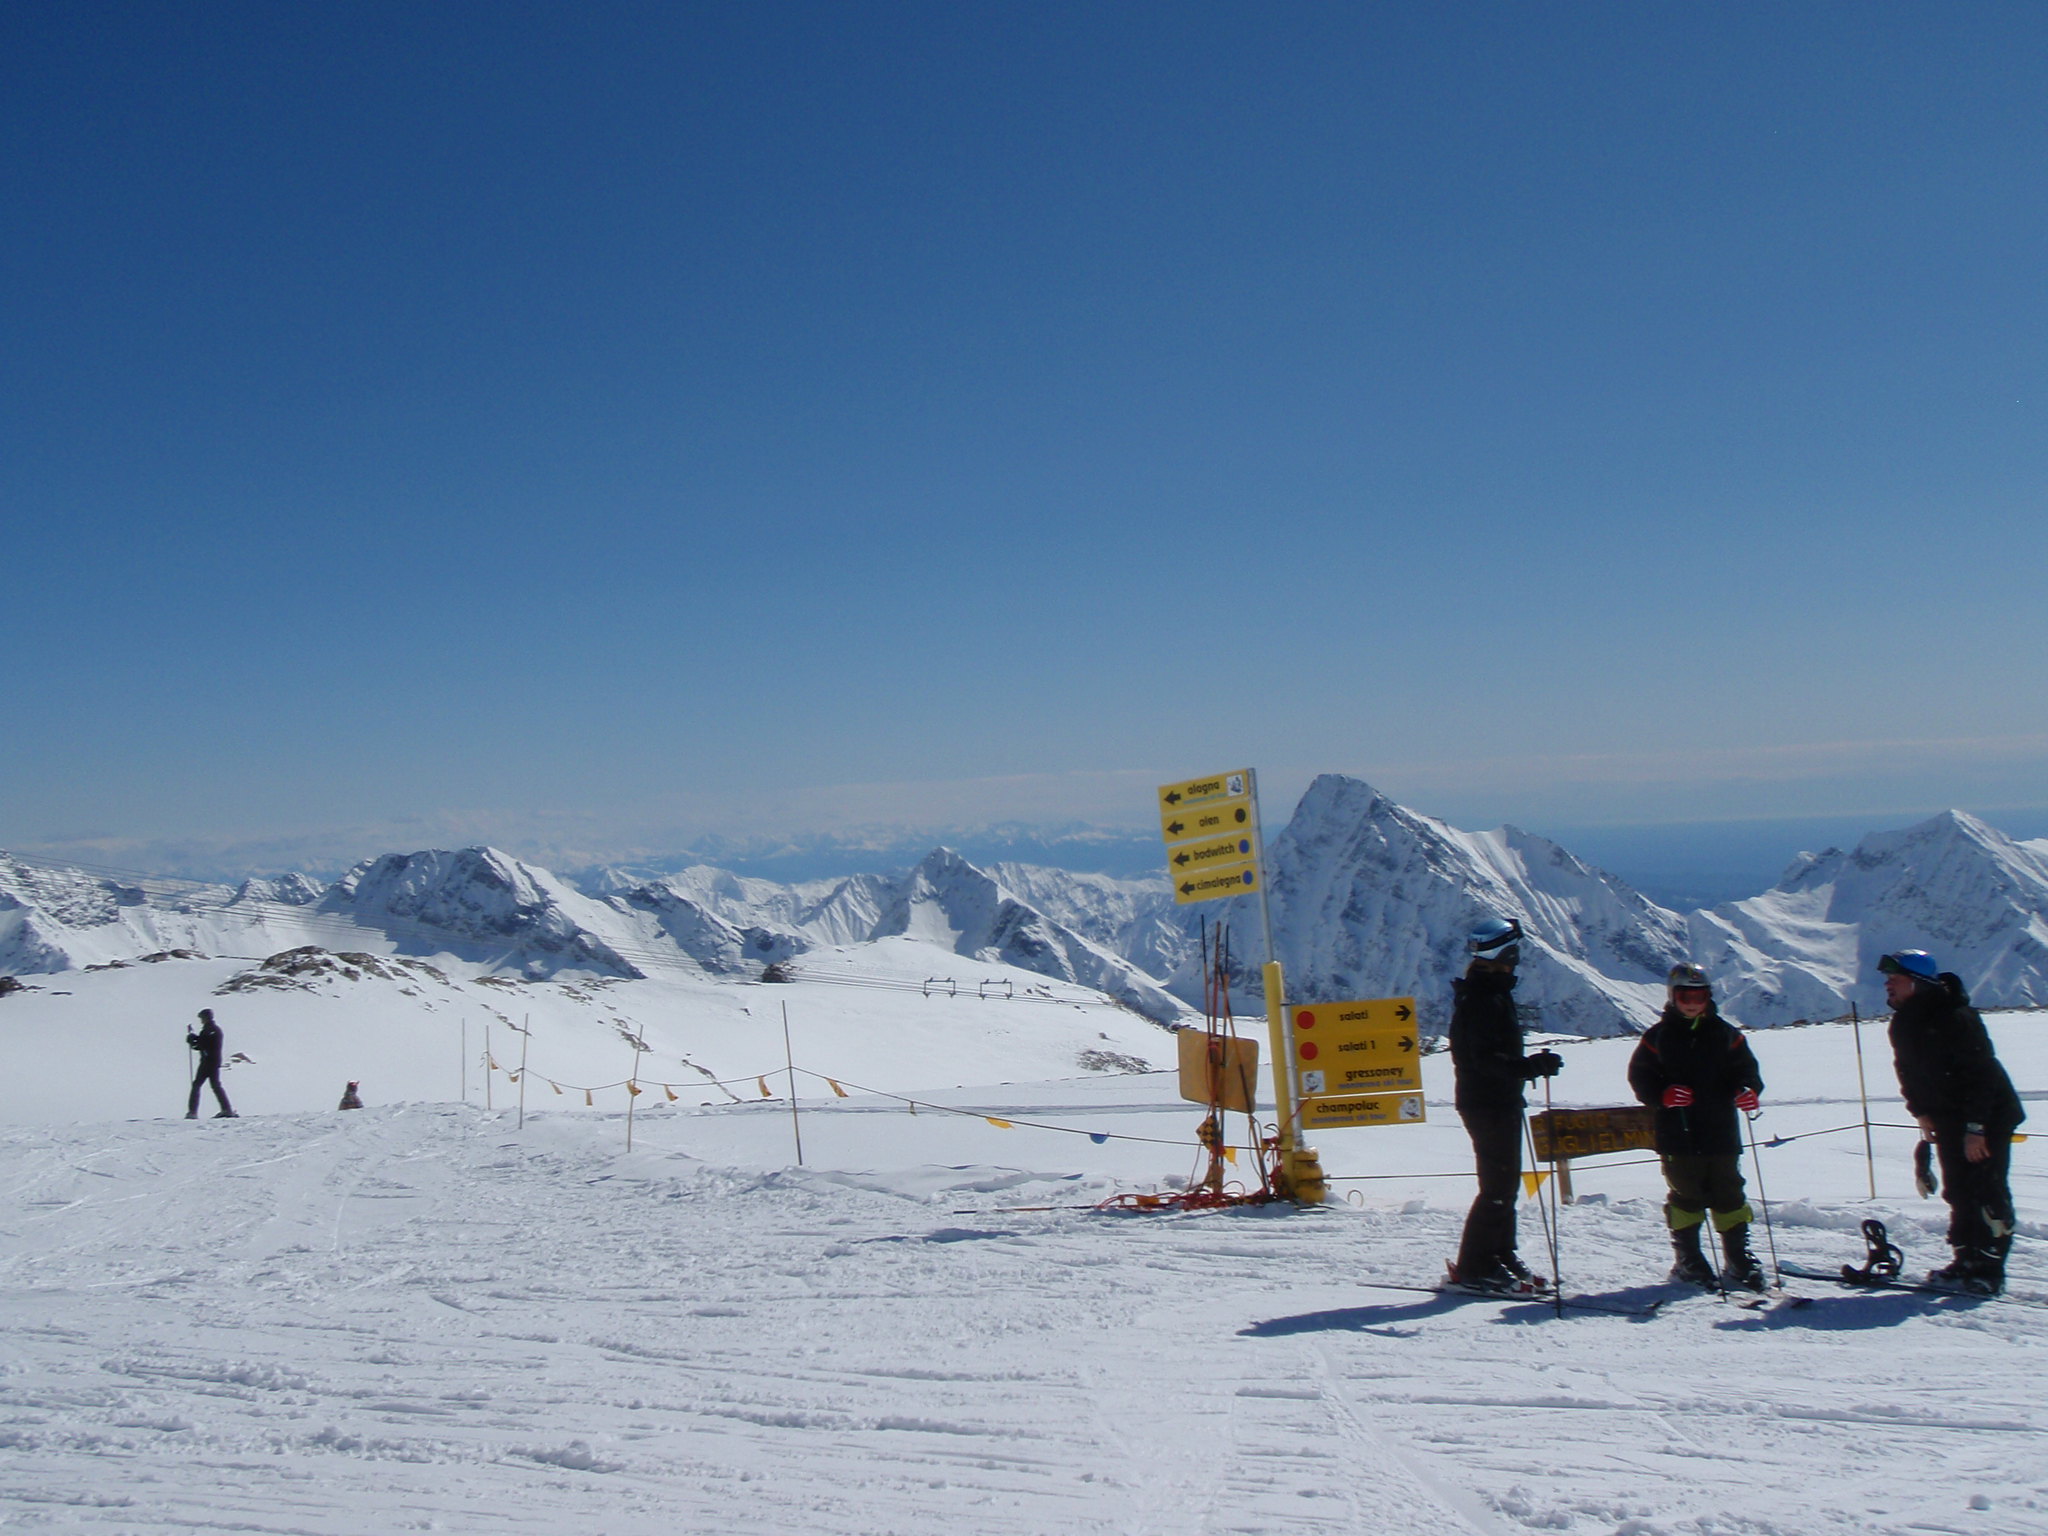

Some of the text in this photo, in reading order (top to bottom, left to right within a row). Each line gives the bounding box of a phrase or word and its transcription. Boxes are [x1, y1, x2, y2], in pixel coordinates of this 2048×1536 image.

[1340, 1010, 1369, 1021] salati
[1338, 1040, 1376, 1052] salati 1
[1345, 1066, 1404, 1081] gressoney
[1316, 1100, 1380, 1113] champoluc
[1534, 1113, 1608, 1130] RFUGIO
